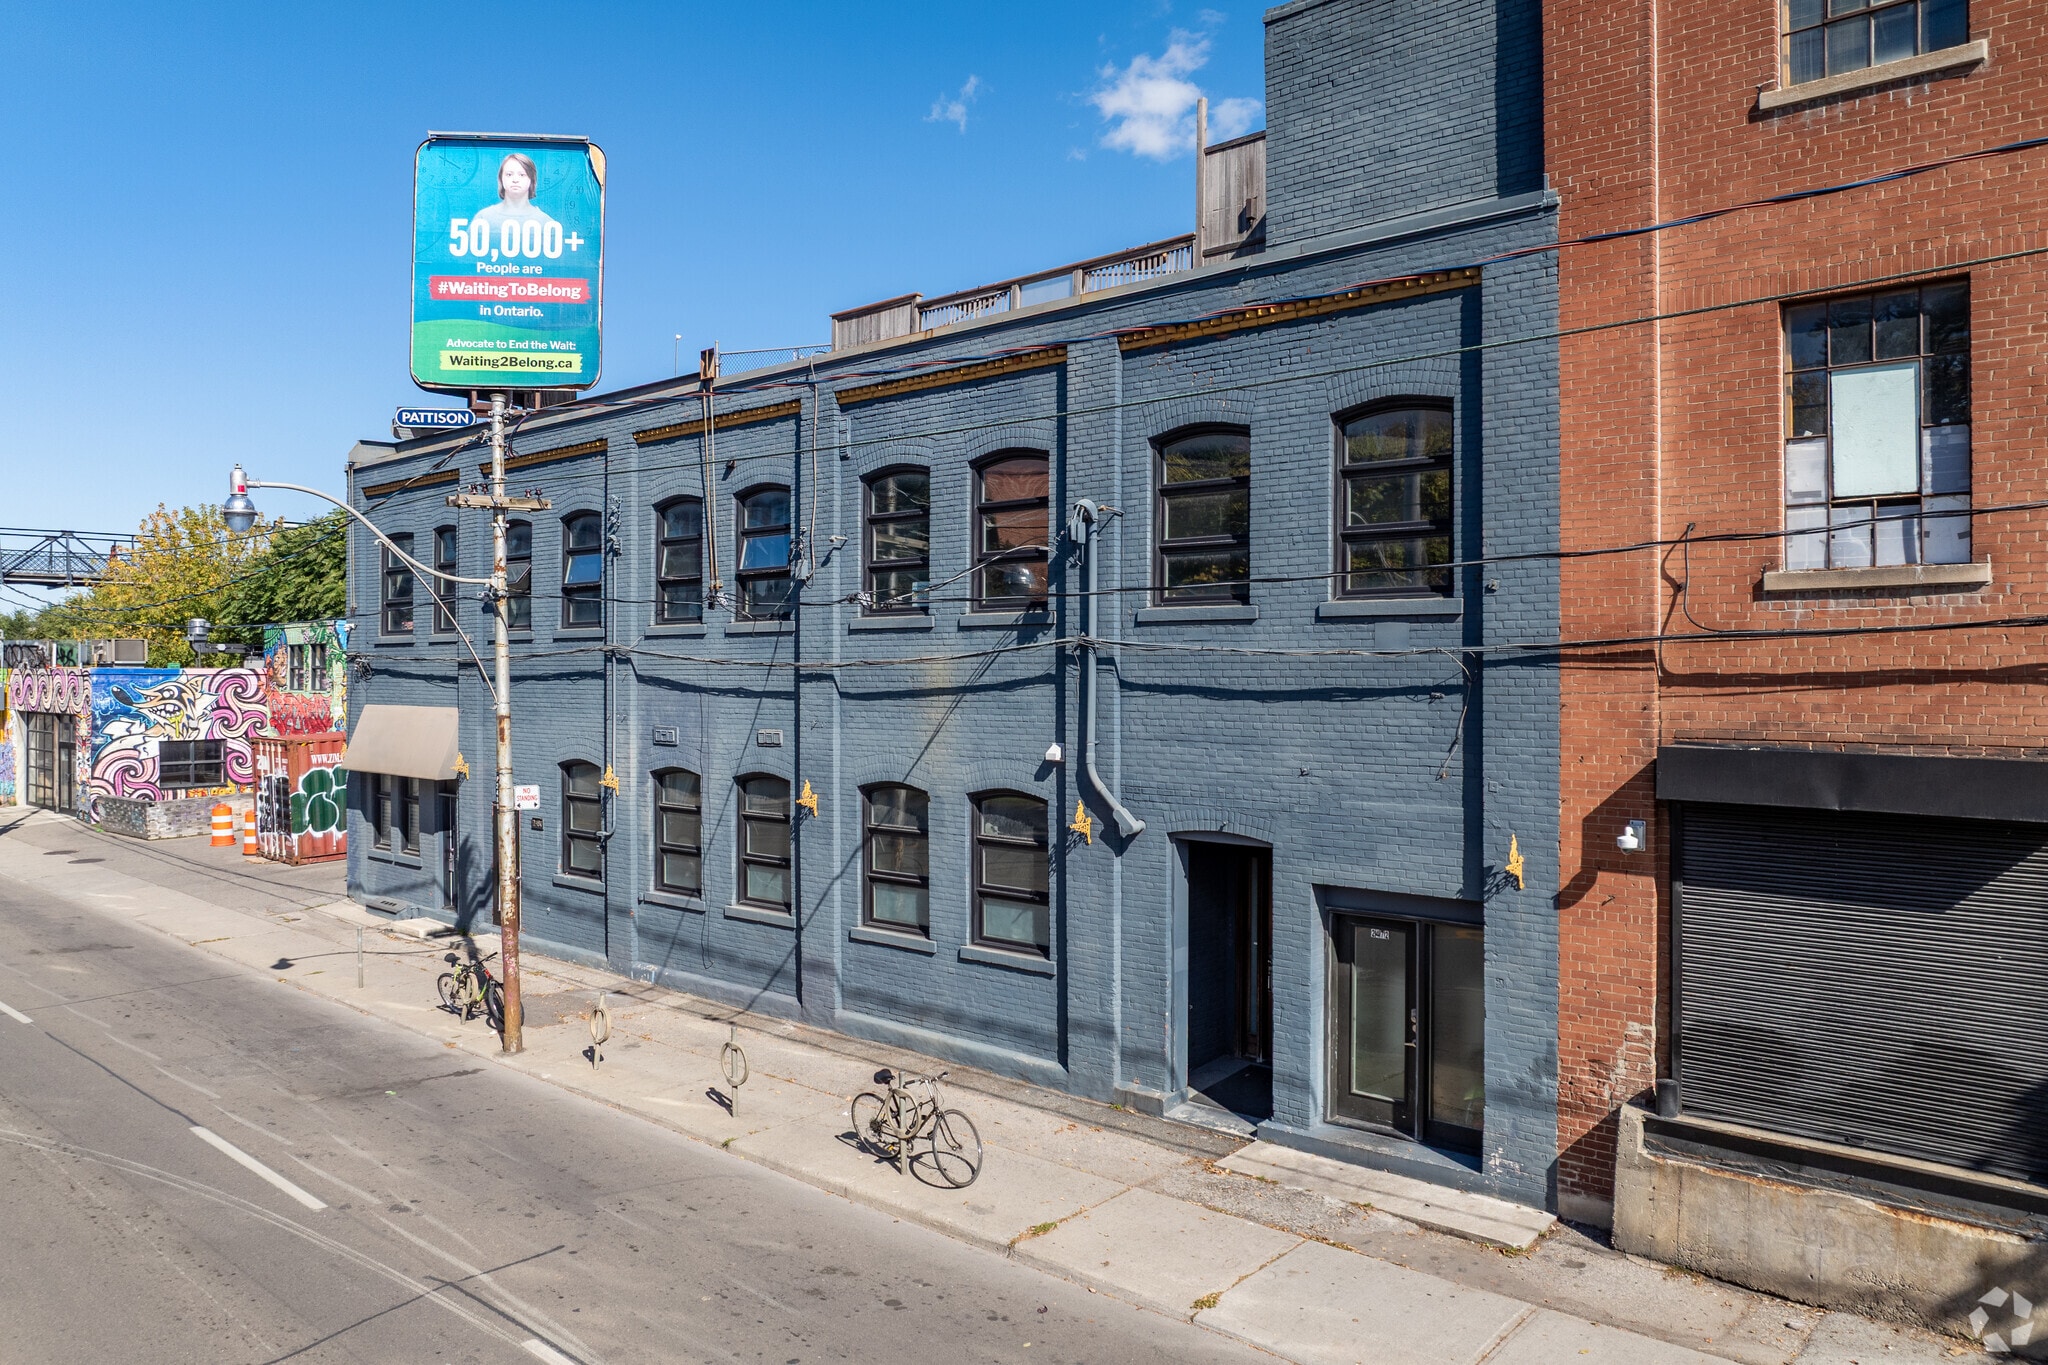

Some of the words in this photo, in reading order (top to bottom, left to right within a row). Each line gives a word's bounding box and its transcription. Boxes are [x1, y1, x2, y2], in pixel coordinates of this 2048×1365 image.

[449, 218, 585, 262] 50,000+
[477, 262, 520, 275] People
[522, 265, 542, 274] are
[438, 281, 581, 299] #WaitingToBelong
[480, 305, 491, 316] in
[494, 305, 544, 317] Ontario.
[446, 338, 494, 348] Advocate
[496, 340, 507, 348] to
[509, 340, 528, 349] End
[531, 340, 547, 349] the
[550, 341, 576, 350] Wait:
[450, 355, 572, 370] Waiting2Belong.ca
[402, 412, 469, 424] PATTISON
